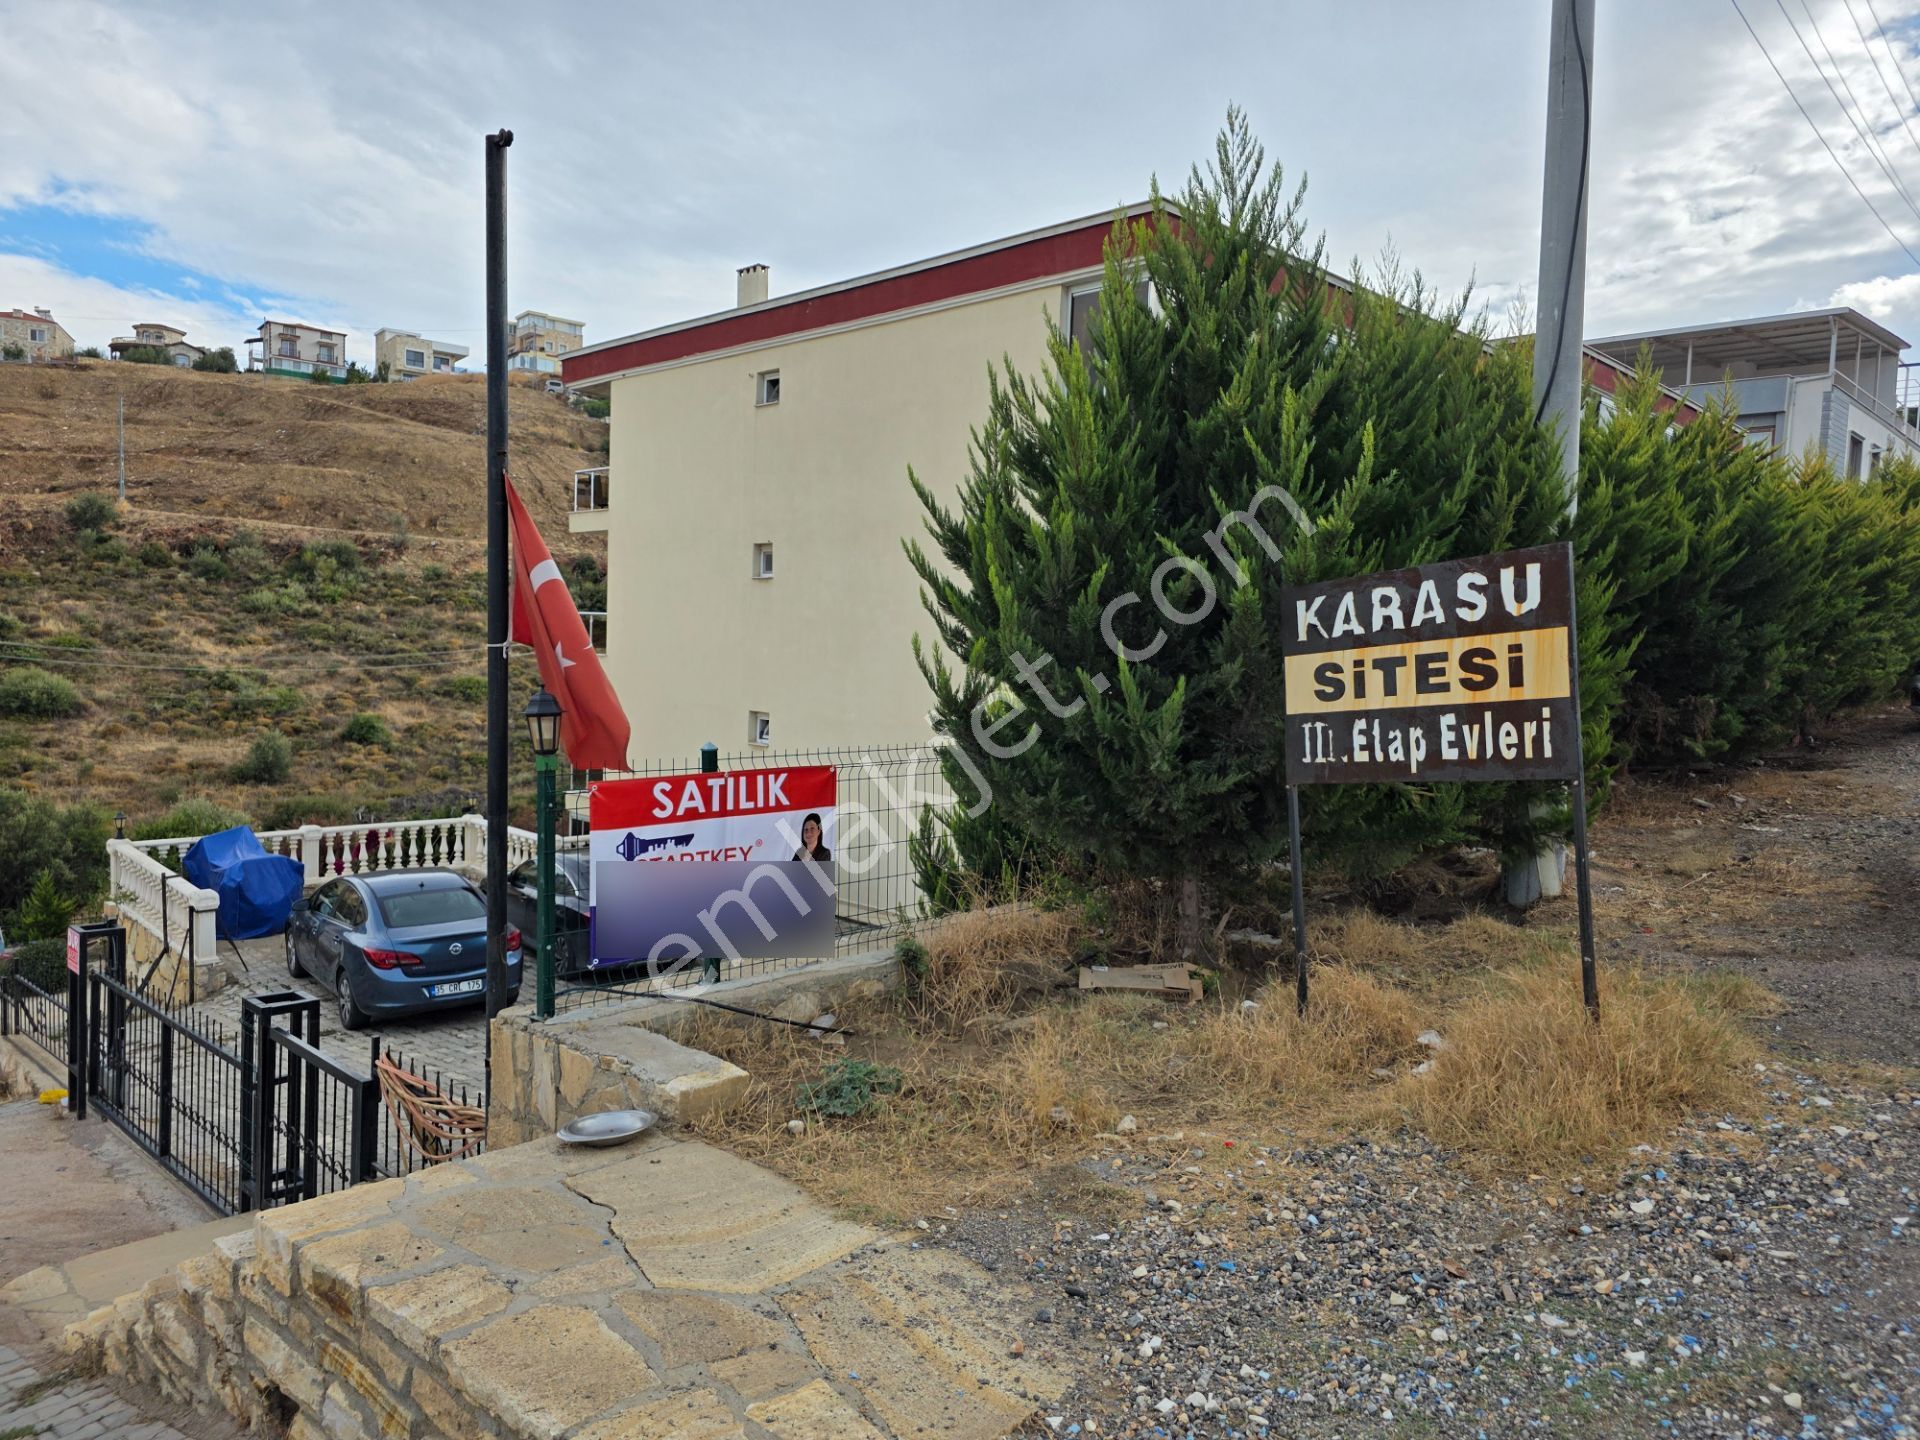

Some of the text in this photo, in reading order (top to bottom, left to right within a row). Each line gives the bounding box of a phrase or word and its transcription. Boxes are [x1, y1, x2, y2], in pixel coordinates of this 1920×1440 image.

[1296, 563, 1541, 642] KARASU
[1440, 707, 1552, 761] Evleri
[652, 773, 790, 818] SATILIK
[635, 845, 753, 862] RTKEY
[467, 980, 481, 990] 175
